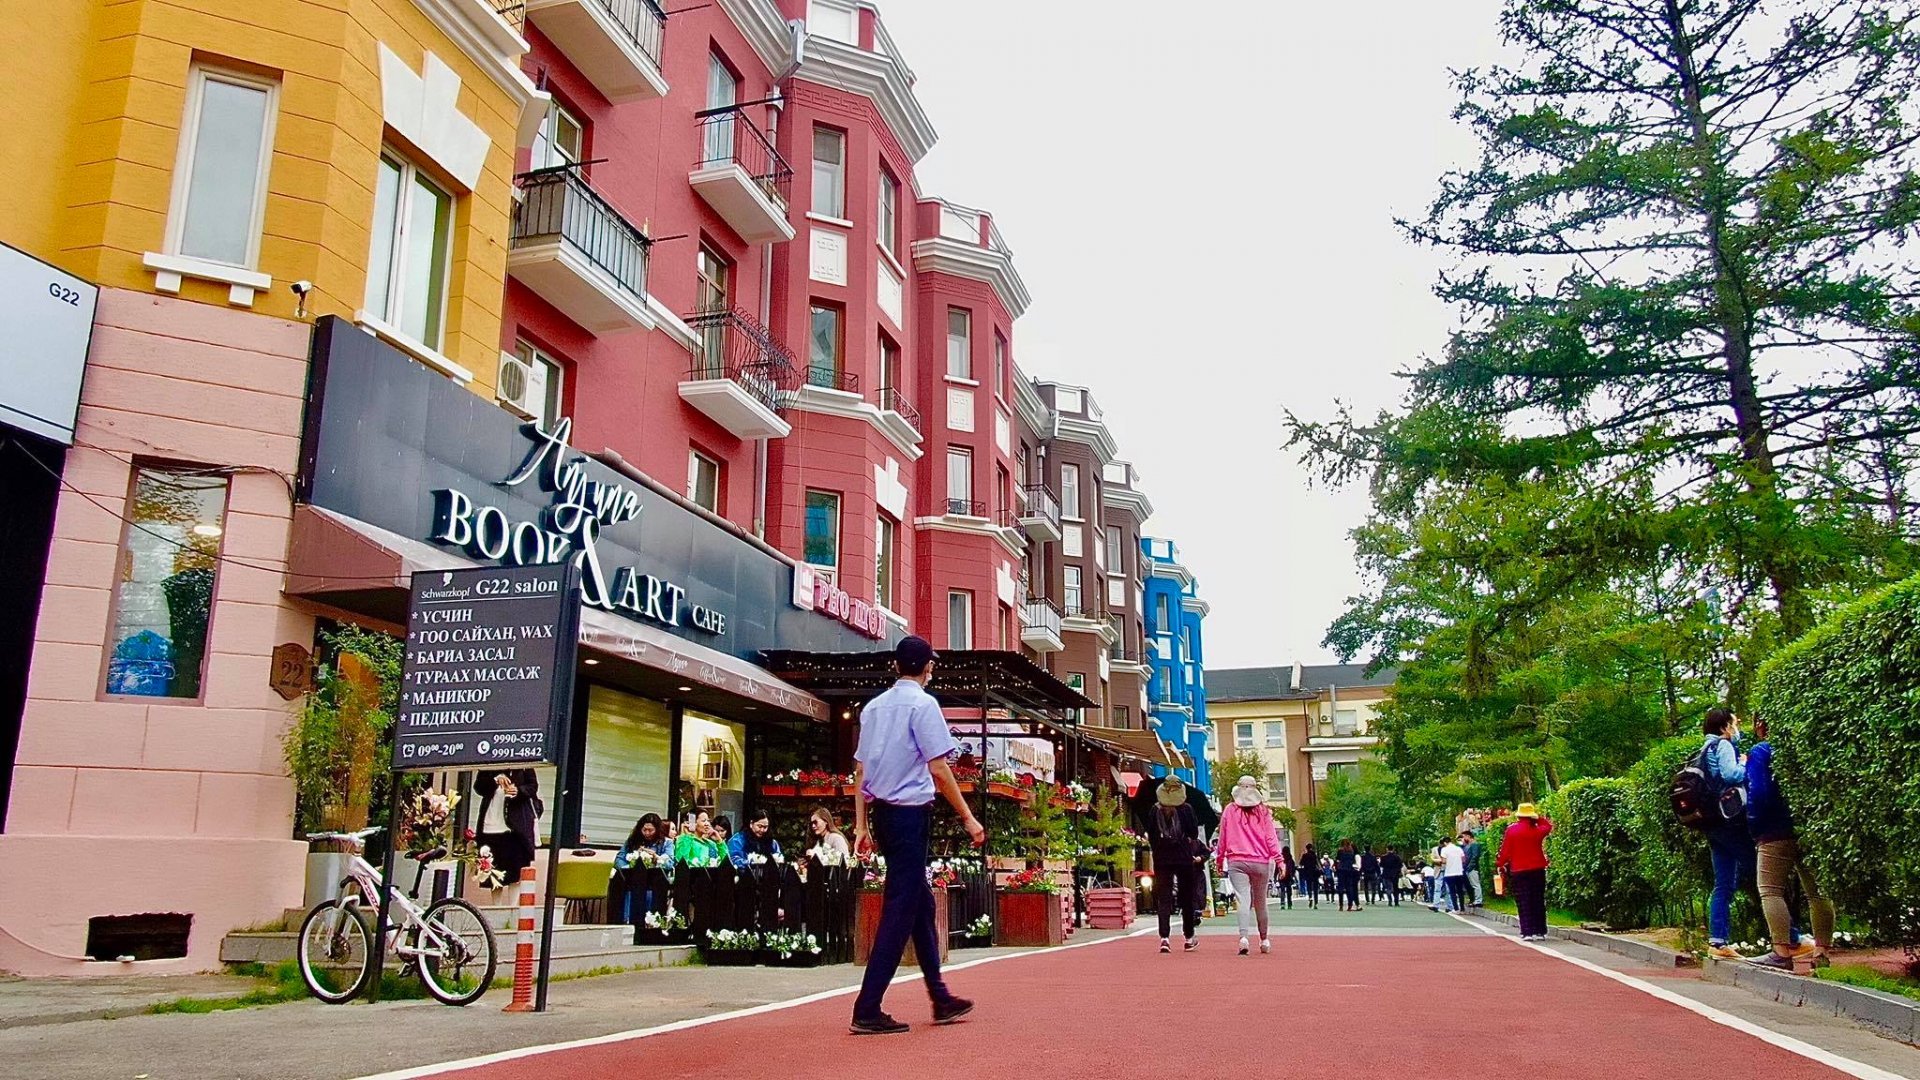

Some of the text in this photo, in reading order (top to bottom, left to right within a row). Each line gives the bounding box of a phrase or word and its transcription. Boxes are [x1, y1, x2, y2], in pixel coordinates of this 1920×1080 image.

[49, 282, 80, 307] G22
[442, 488, 727, 636] BOOK & ART CAFE
[420, 586, 472, 600] Schwarzkopf
[475, 577, 559, 596] G22 salon
[418, 624, 554, 645] ГОО САЙХАН, WAX
[416, 646, 516, 665] БАРИА ЗАСАЛ
[414, 665, 542, 685] ТУРААХ МАССАЖ
[411, 688, 492, 706] МАНИКЮР
[409, 709, 486, 728] ПЕДИКЮР
[493, 732, 544, 744] 9990-5272
[491, 746, 543, 758] 9991-4842
